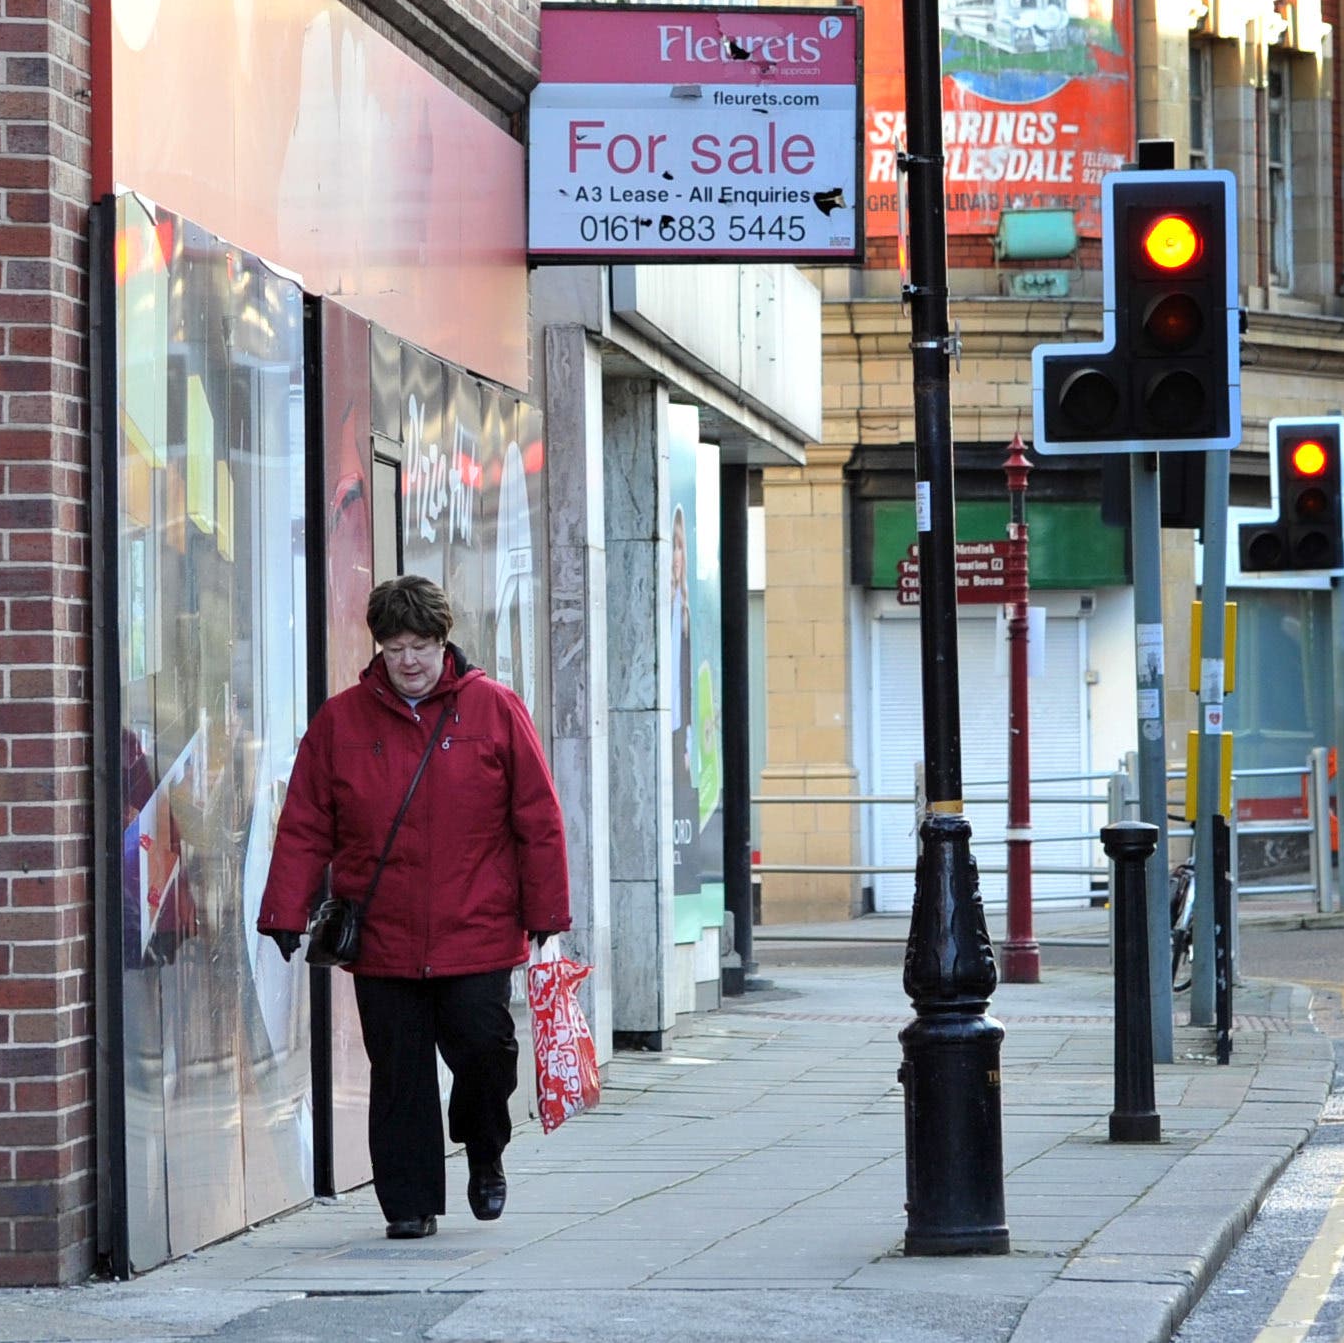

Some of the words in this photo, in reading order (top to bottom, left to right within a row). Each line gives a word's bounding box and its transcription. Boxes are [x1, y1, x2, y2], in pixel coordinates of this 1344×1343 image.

[657, 24, 822, 64] Fleurets
[713, 90, 820, 107] fleurets.com
[568, 120, 668, 175] For
[690, 121, 816, 176] sale
[574, 186, 603, 203] A3
[610, 186, 670, 203] Lease
[689, 186, 713, 203] All
[720, 186, 811, 207] Enquiries
[580, 216, 640, 242] 0161
[658, 216, 716, 242] 683
[729, 216, 806, 242] 5445
[404, 392, 448, 546] Pizza
[449, 415, 480, 548] Hut
[973, 575, 1005, 587] Bureau
